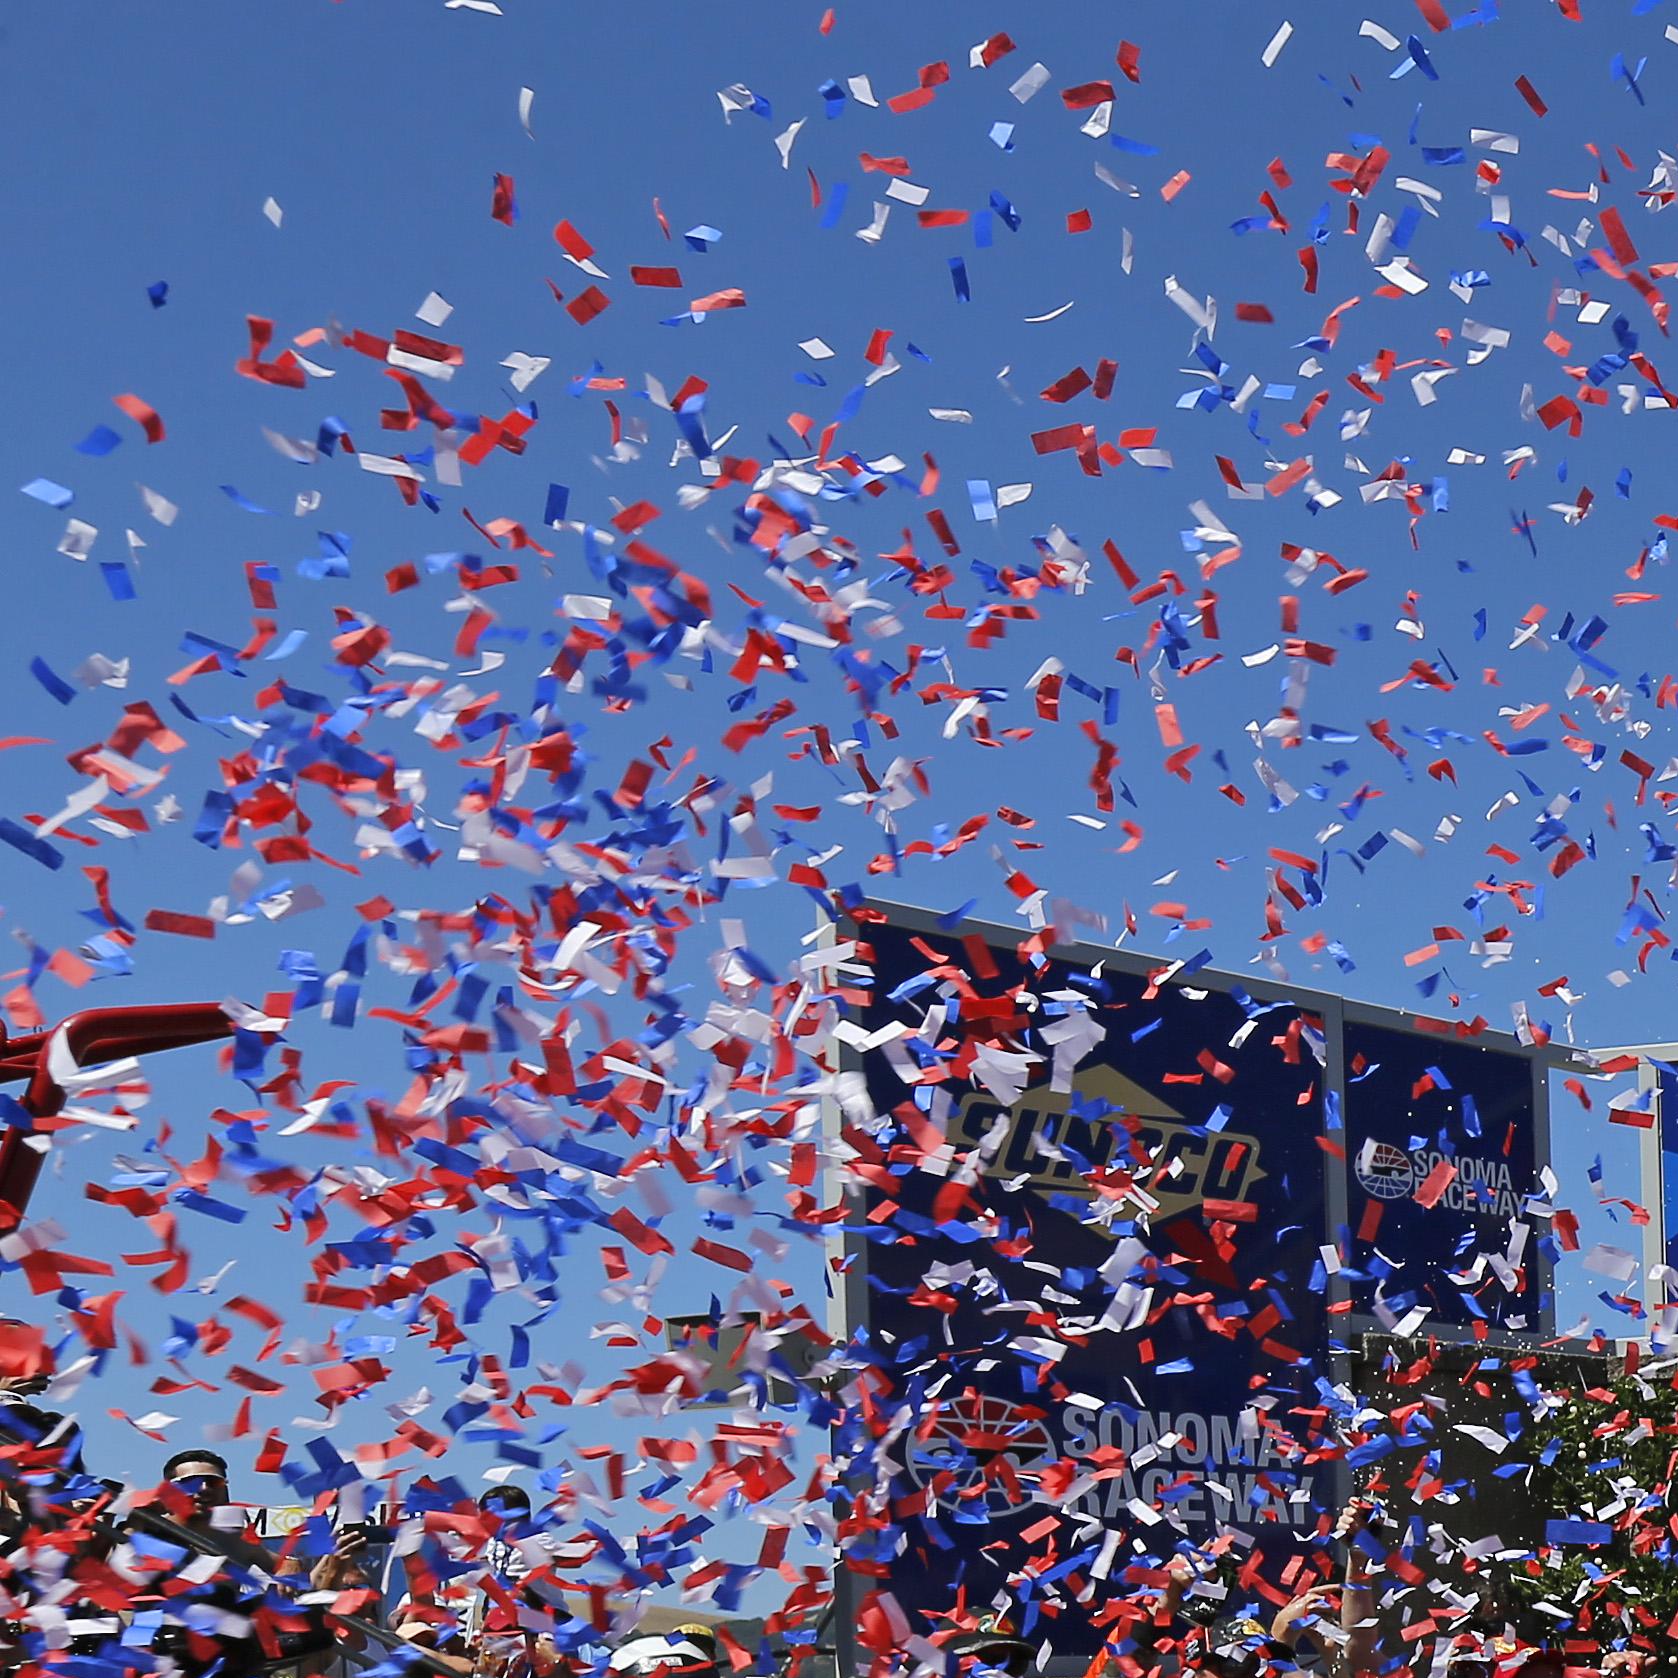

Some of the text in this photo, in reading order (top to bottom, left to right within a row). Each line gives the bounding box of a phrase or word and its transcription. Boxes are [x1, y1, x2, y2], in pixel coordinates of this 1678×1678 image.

[960, 1102, 1246, 1202] SUNCO
[1414, 1150, 1512, 1190] SONOMA
[1063, 1405, 1294, 1469] SONOMA
